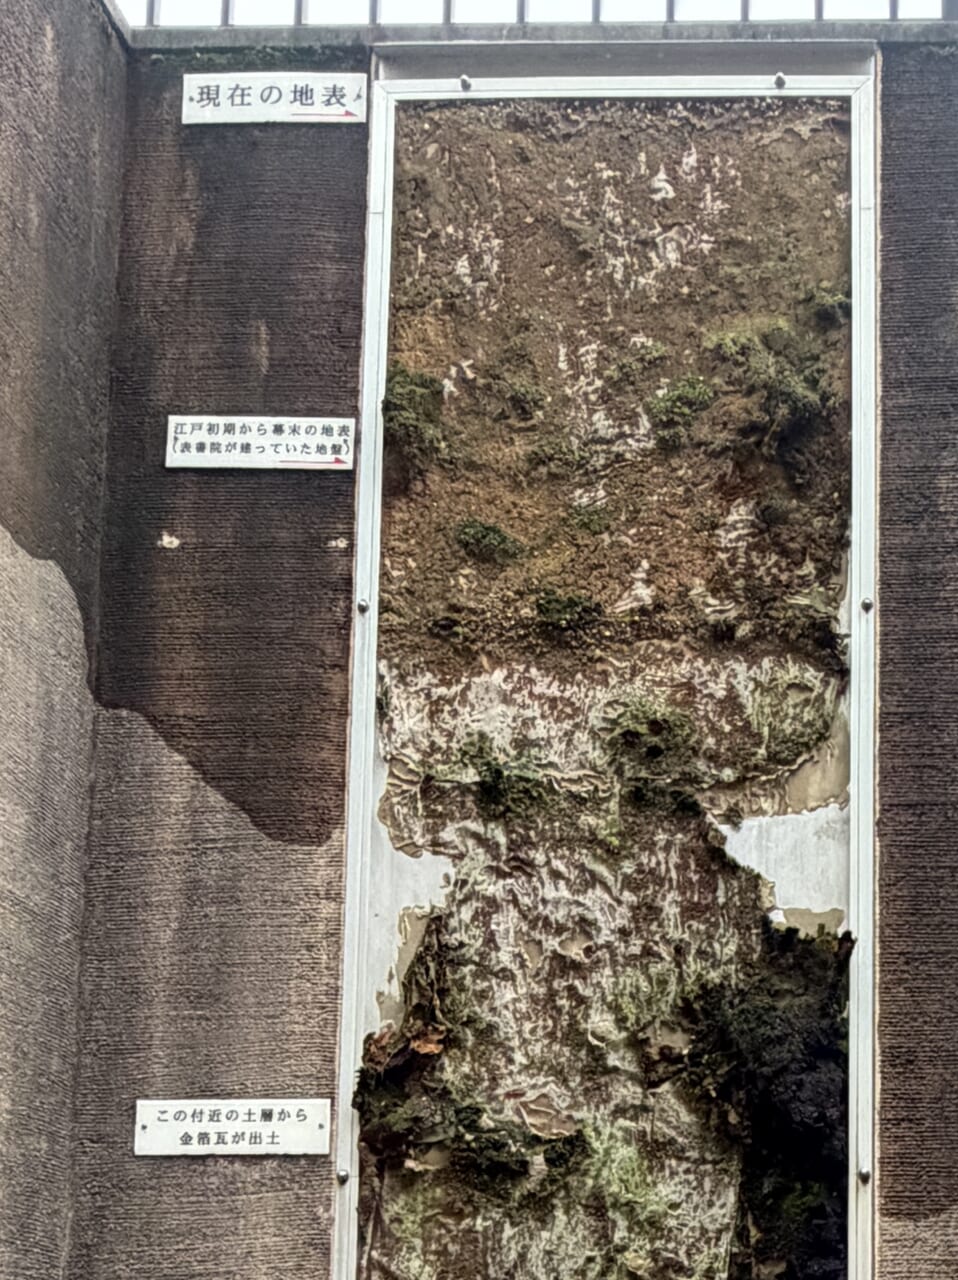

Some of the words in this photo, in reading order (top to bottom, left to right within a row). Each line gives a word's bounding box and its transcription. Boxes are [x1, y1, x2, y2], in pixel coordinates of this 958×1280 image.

[196, 83, 347, 108] 現在の地表
[174, 422, 350, 437] 江戸初期から幕末の地表
[156, 1108, 308, 1123] この付近の土層から
[179, 1131, 281, 1146] 金箔瓦が出土
